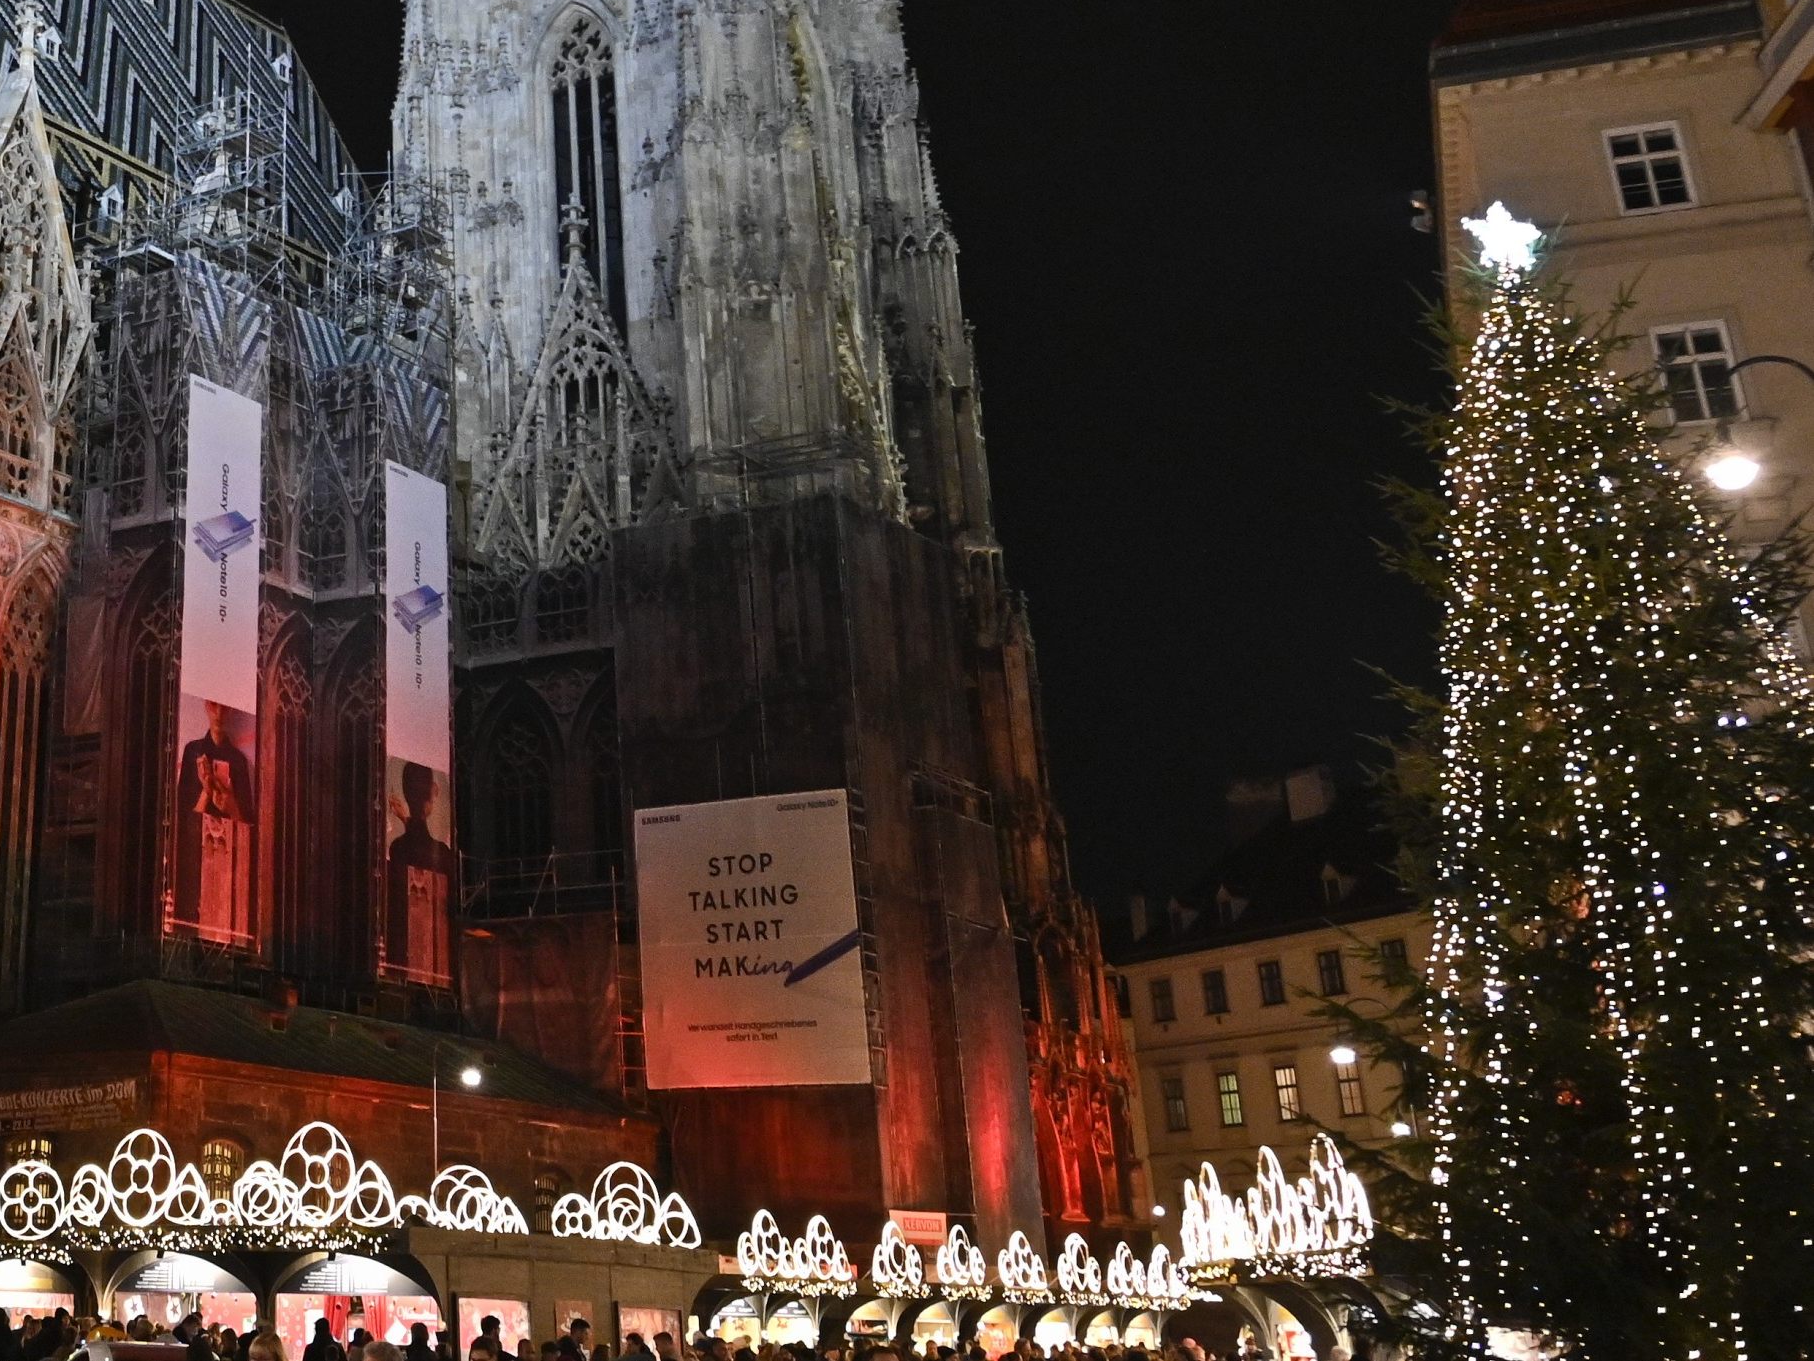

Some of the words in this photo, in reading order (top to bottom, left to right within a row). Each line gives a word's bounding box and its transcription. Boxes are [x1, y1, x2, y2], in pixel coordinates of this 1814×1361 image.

[220, 463, 230, 512] Galaxy
[219, 552, 228, 598] Note10
[413, 541, 422, 586] Galaxy
[414, 624, 423, 666] Note10
[776, 801, 806, 812] Galaxy
[641, 814, 681, 826] SAMSUNG
[708, 853, 773, 877] STOP
[688, 884, 799, 912] TALKING
[706, 919, 784, 944] START
[688, 1021, 734, 1032] Verwandelt
[726, 1033, 751, 1042] sofort
[752, 1033, 760, 1041] in
[760, 1031, 778, 1041] Text
[905, 1218, 940, 1232] XERVON
